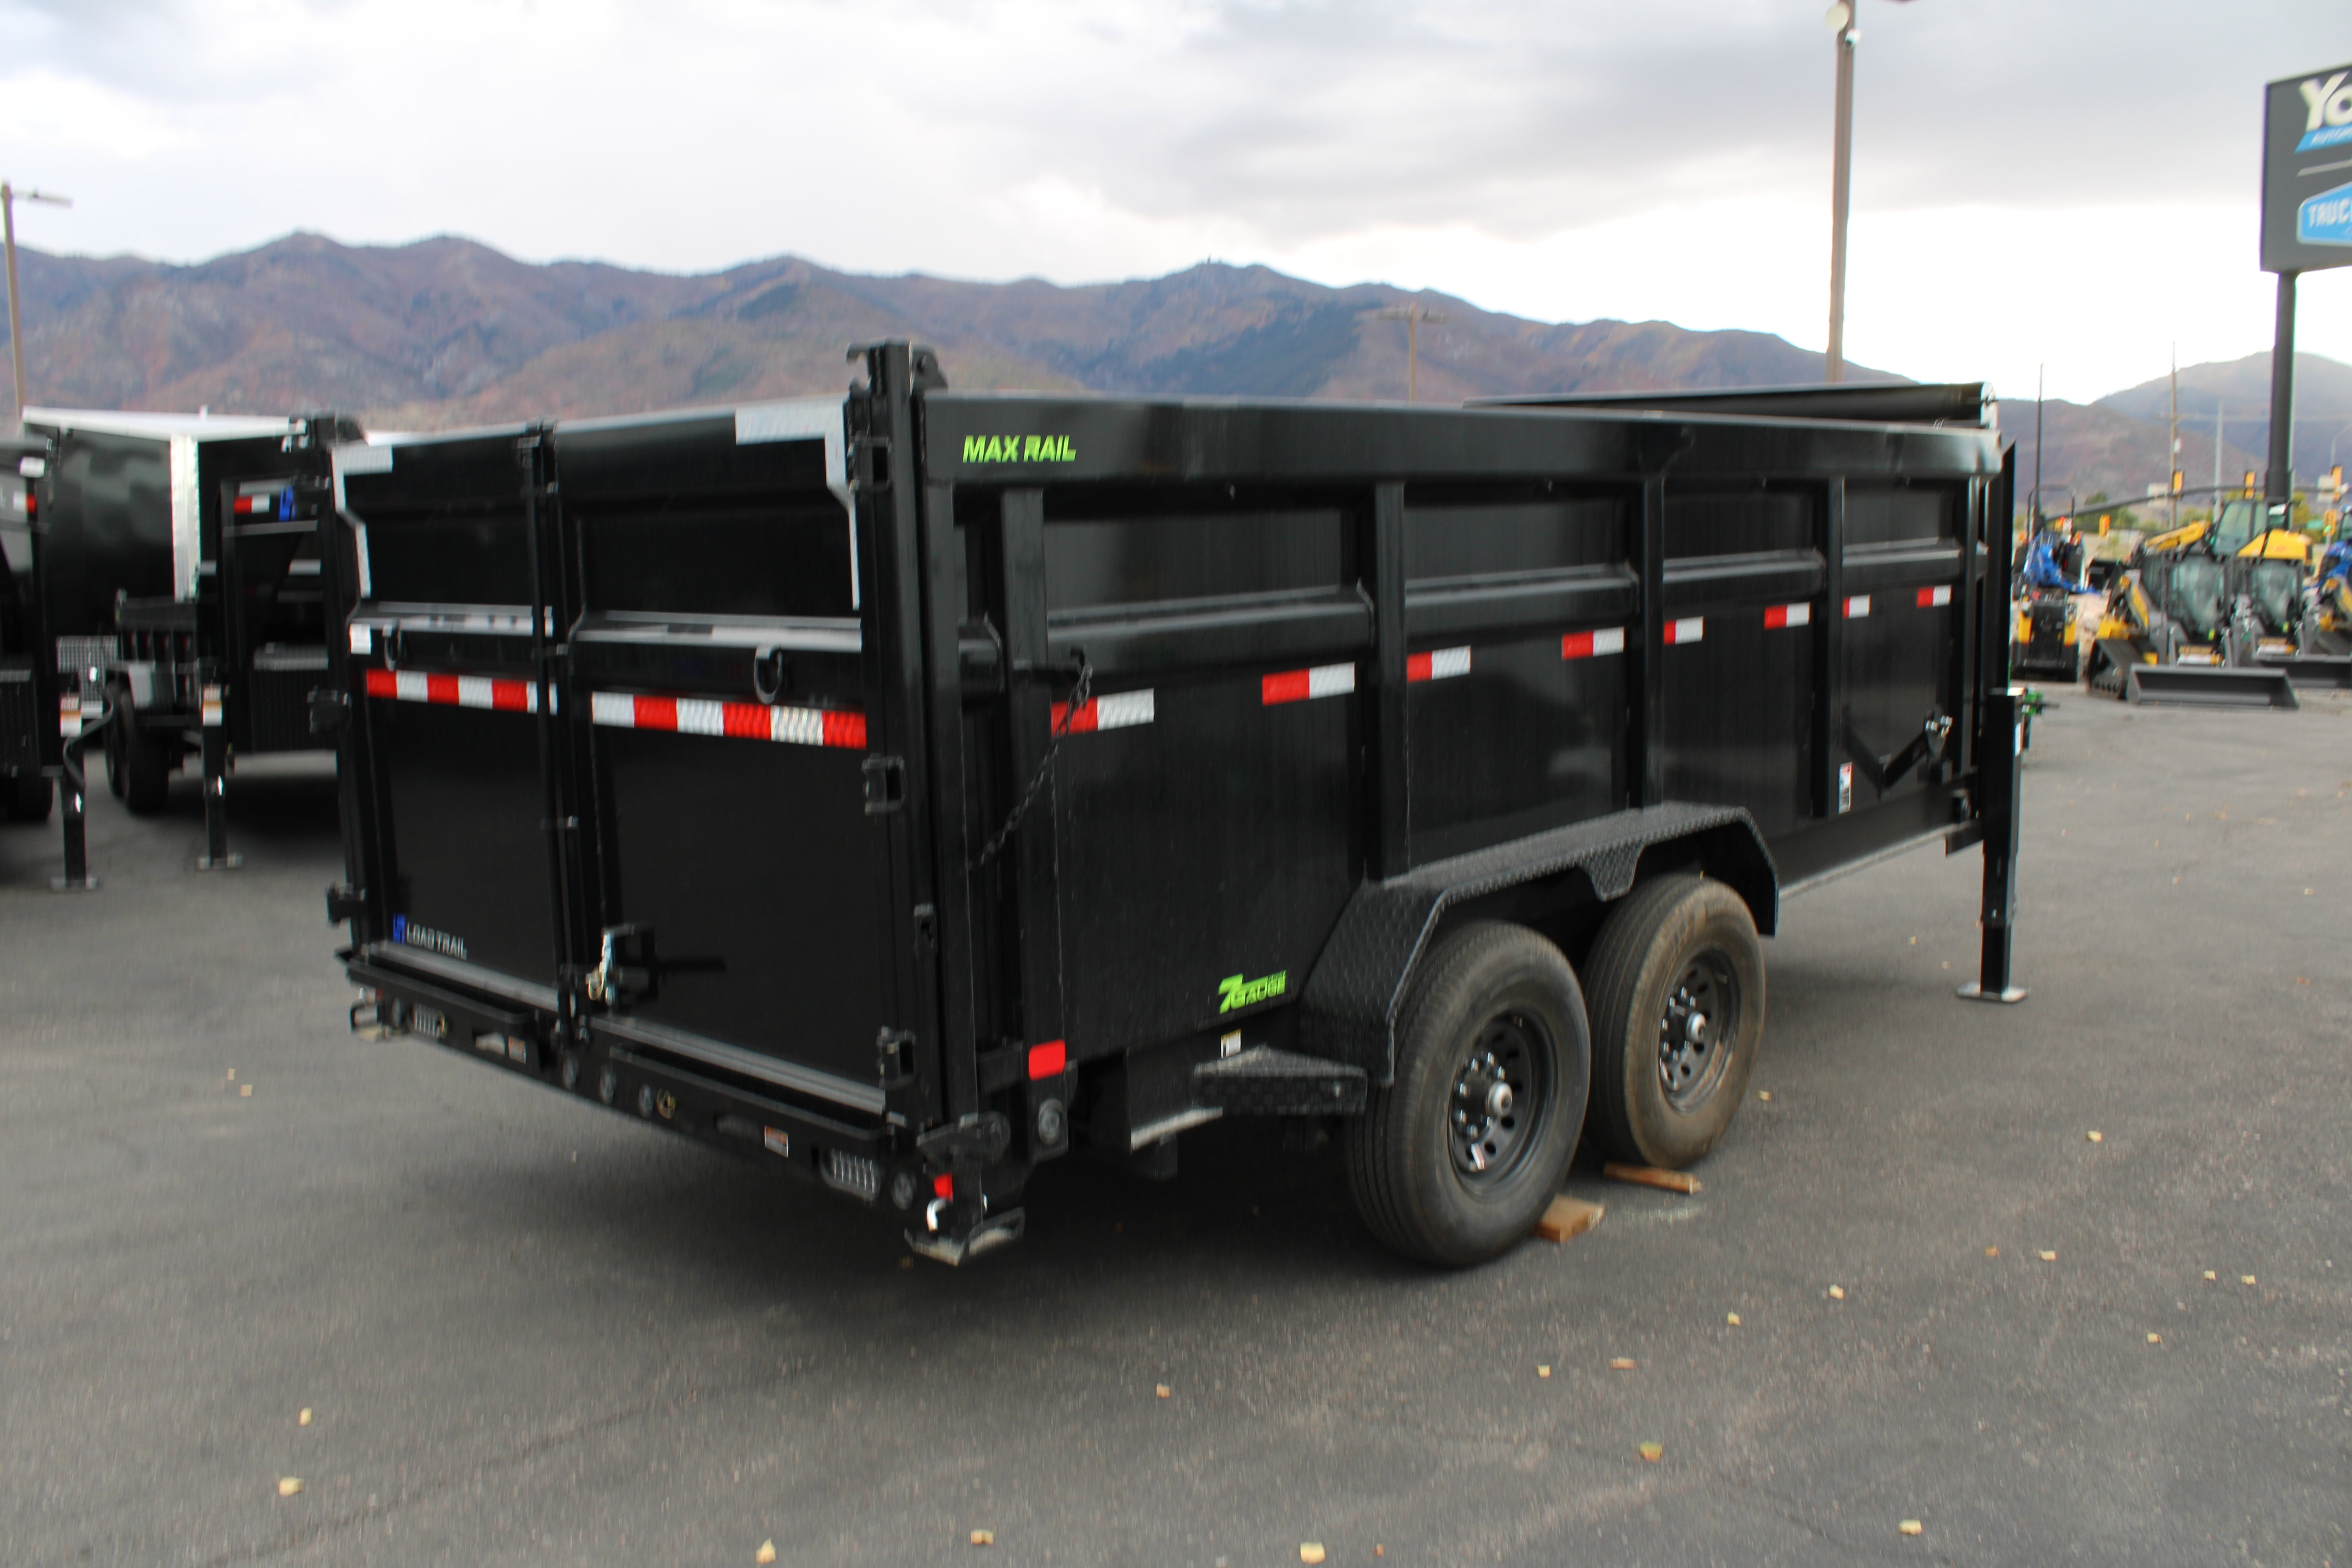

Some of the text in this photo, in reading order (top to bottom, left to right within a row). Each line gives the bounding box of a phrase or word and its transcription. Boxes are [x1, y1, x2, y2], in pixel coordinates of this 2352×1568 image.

[2307, 198, 2352, 228] TRUC
[963, 435, 1077, 463] MAX RAIL
